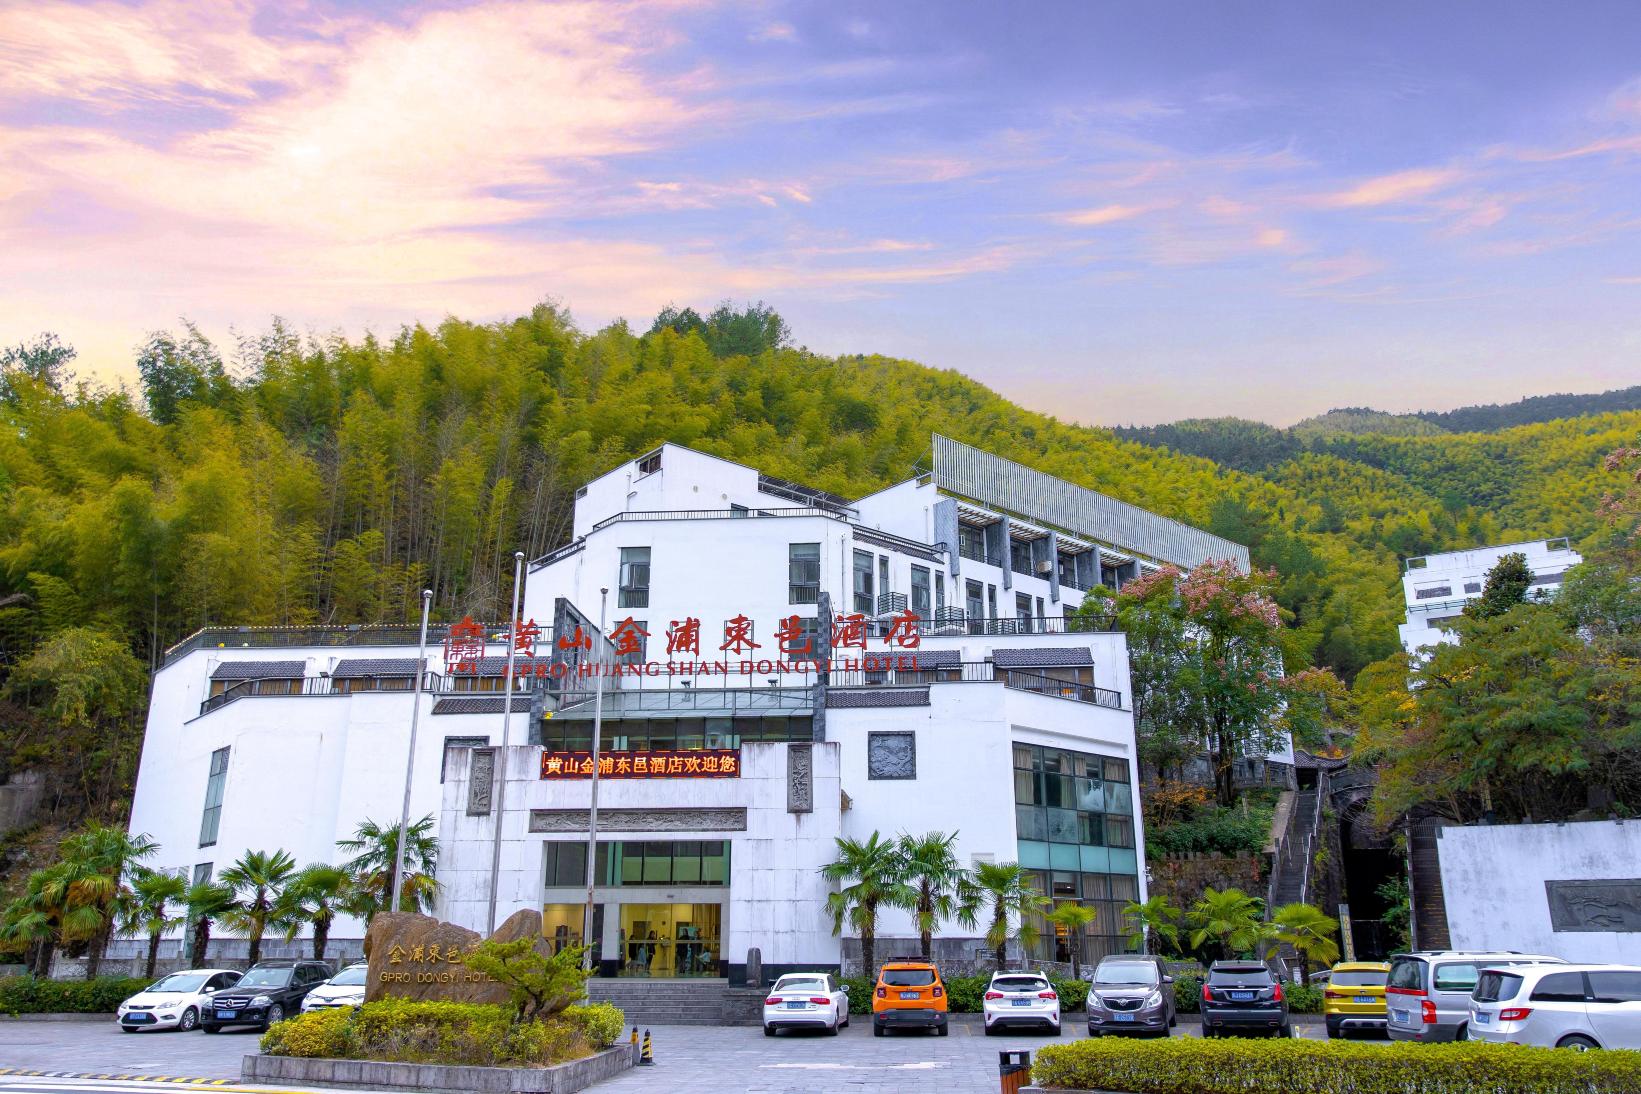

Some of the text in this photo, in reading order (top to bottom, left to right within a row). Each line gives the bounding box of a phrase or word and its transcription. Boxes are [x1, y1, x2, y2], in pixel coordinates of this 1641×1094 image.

[740, 658, 832, 675] DONGYI
[844, 655, 922, 673] HOTEL
[545, 755, 736, 775] 黄山金浦东邑酒店欢迎您
[379, 971, 499, 983] GPRO DONGYI HOTE
